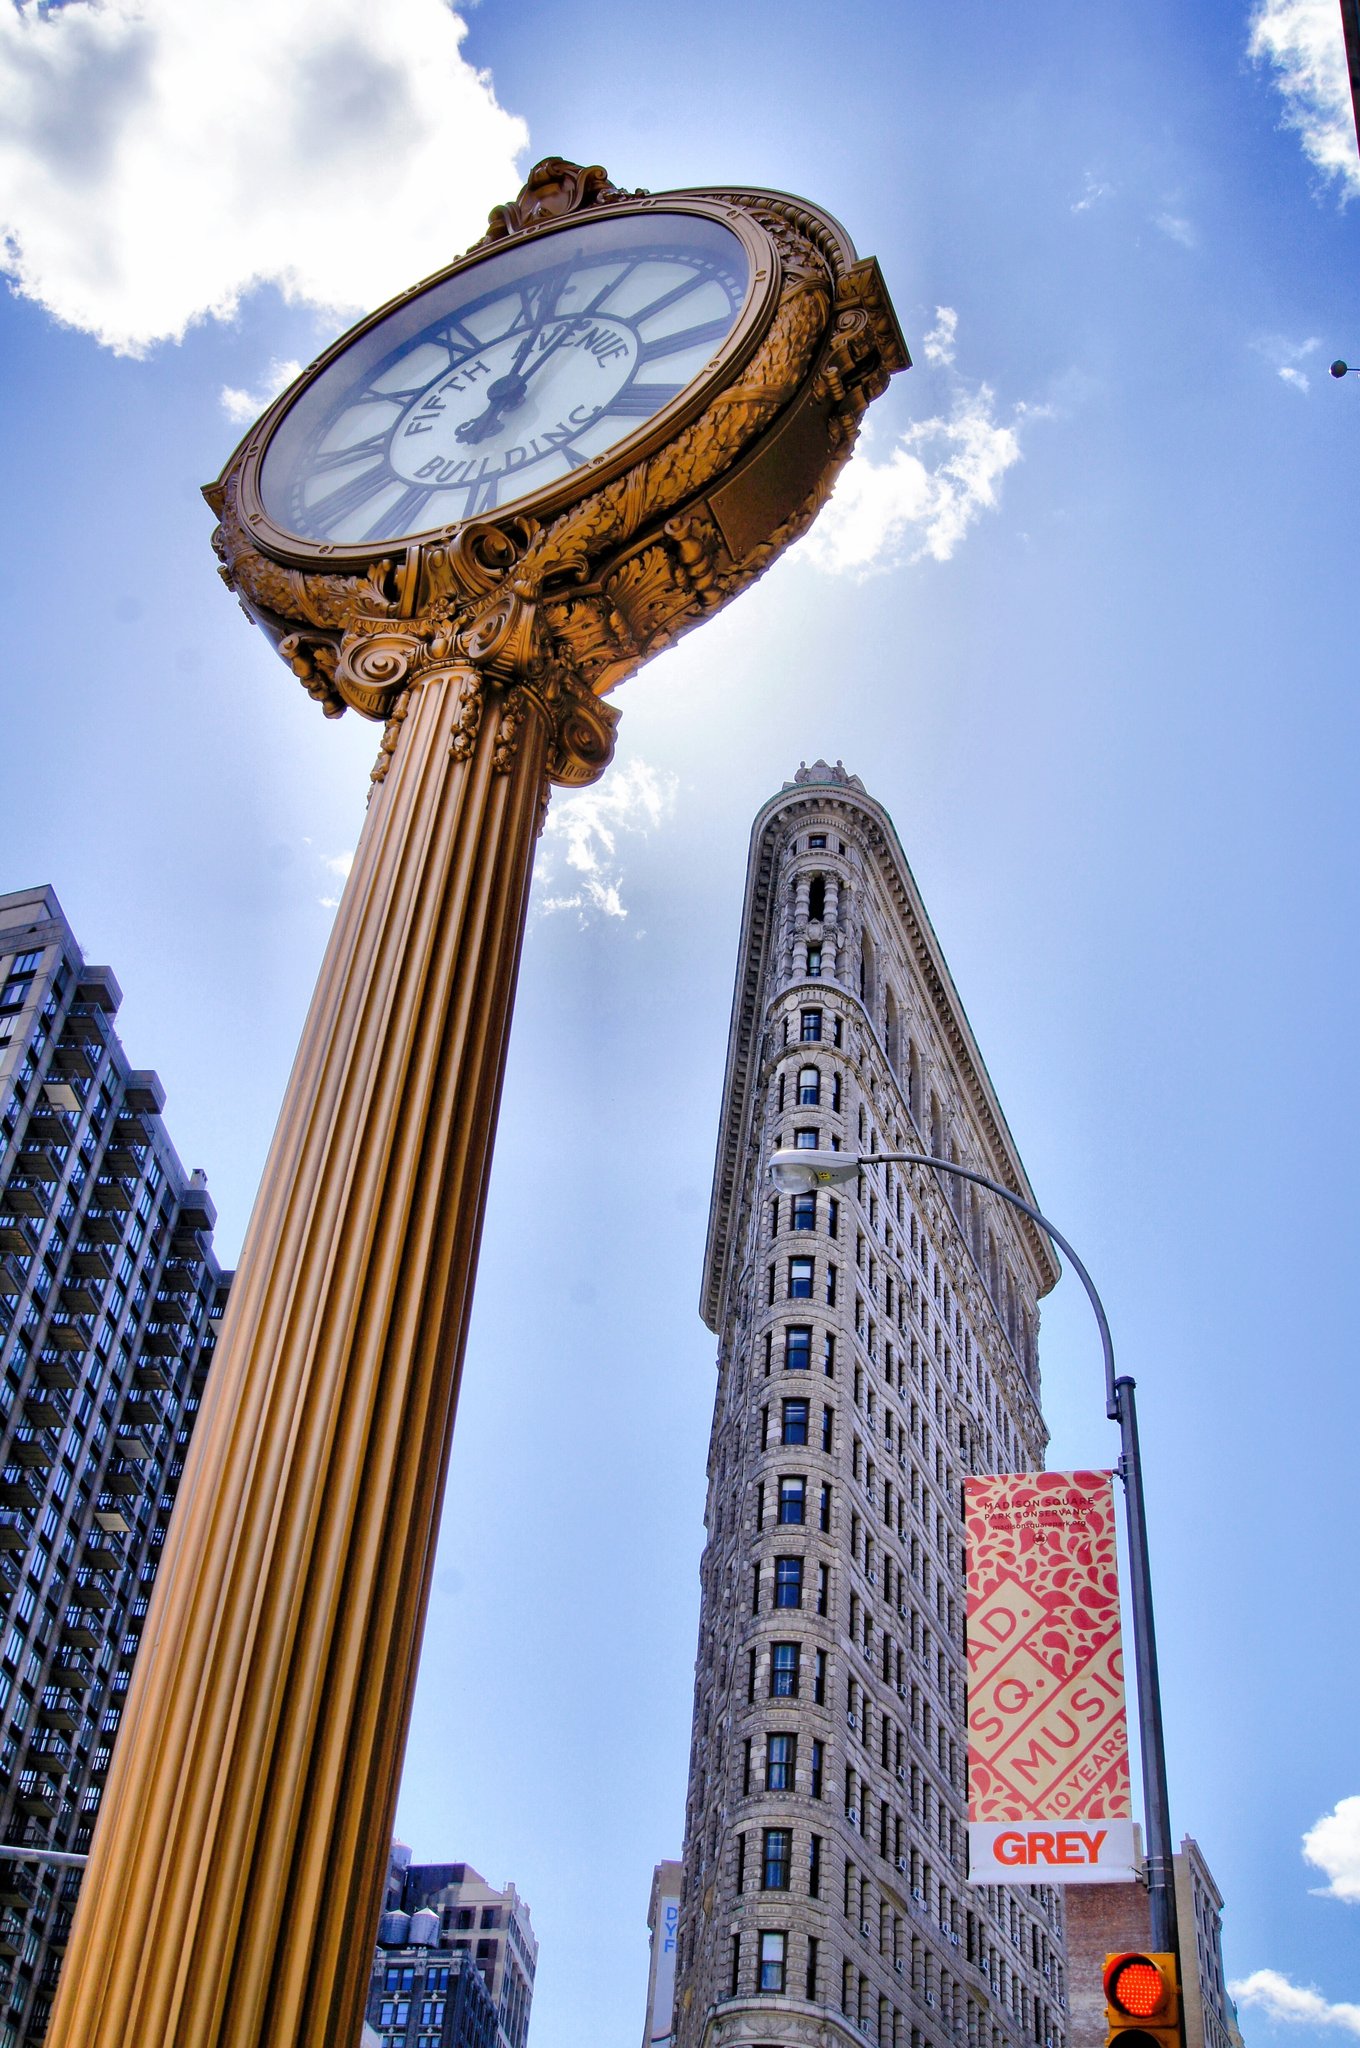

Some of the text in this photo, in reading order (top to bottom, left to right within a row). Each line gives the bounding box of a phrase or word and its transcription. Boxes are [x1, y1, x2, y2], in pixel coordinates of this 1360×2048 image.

[404, 325, 629, 437] FIFTH AVENUE
[413, 404, 602, 482] BUILDING
[984, 1497, 1094, 1510] MADISON SQUARE
[984, 1508, 1095, 1521] PARK CONSERVANCY
[992, 1520, 1086, 1530] madisonsquarepark.org
[969, 1678, 1045, 1742] SQ.
[1046, 1728, 1128, 1816] 10 YEARS
[993, 1830, 1107, 1865] GREY
